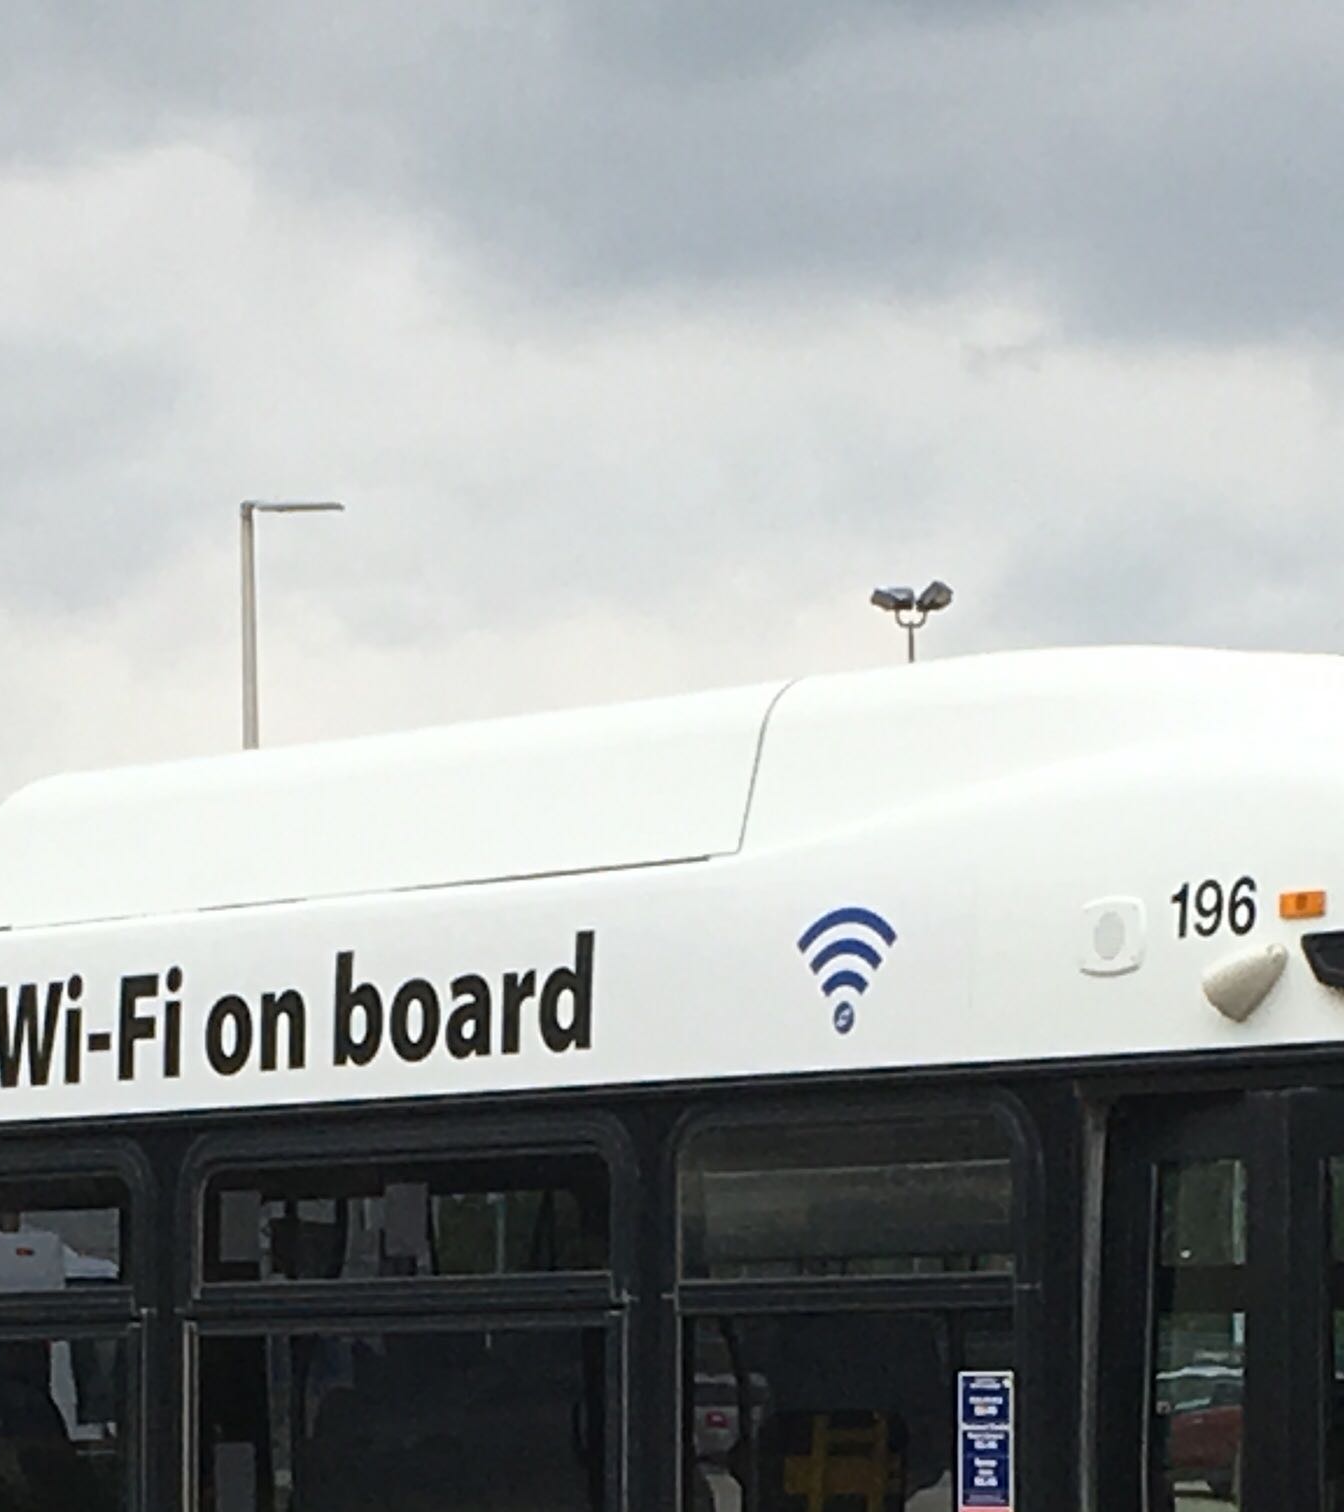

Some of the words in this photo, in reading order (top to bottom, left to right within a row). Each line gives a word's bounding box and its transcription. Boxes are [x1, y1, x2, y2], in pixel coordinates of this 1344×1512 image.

[1171, 876, 1257, 939] 196
[205, 989, 306, 1076] on
[333, 930, 595, 1067] board
